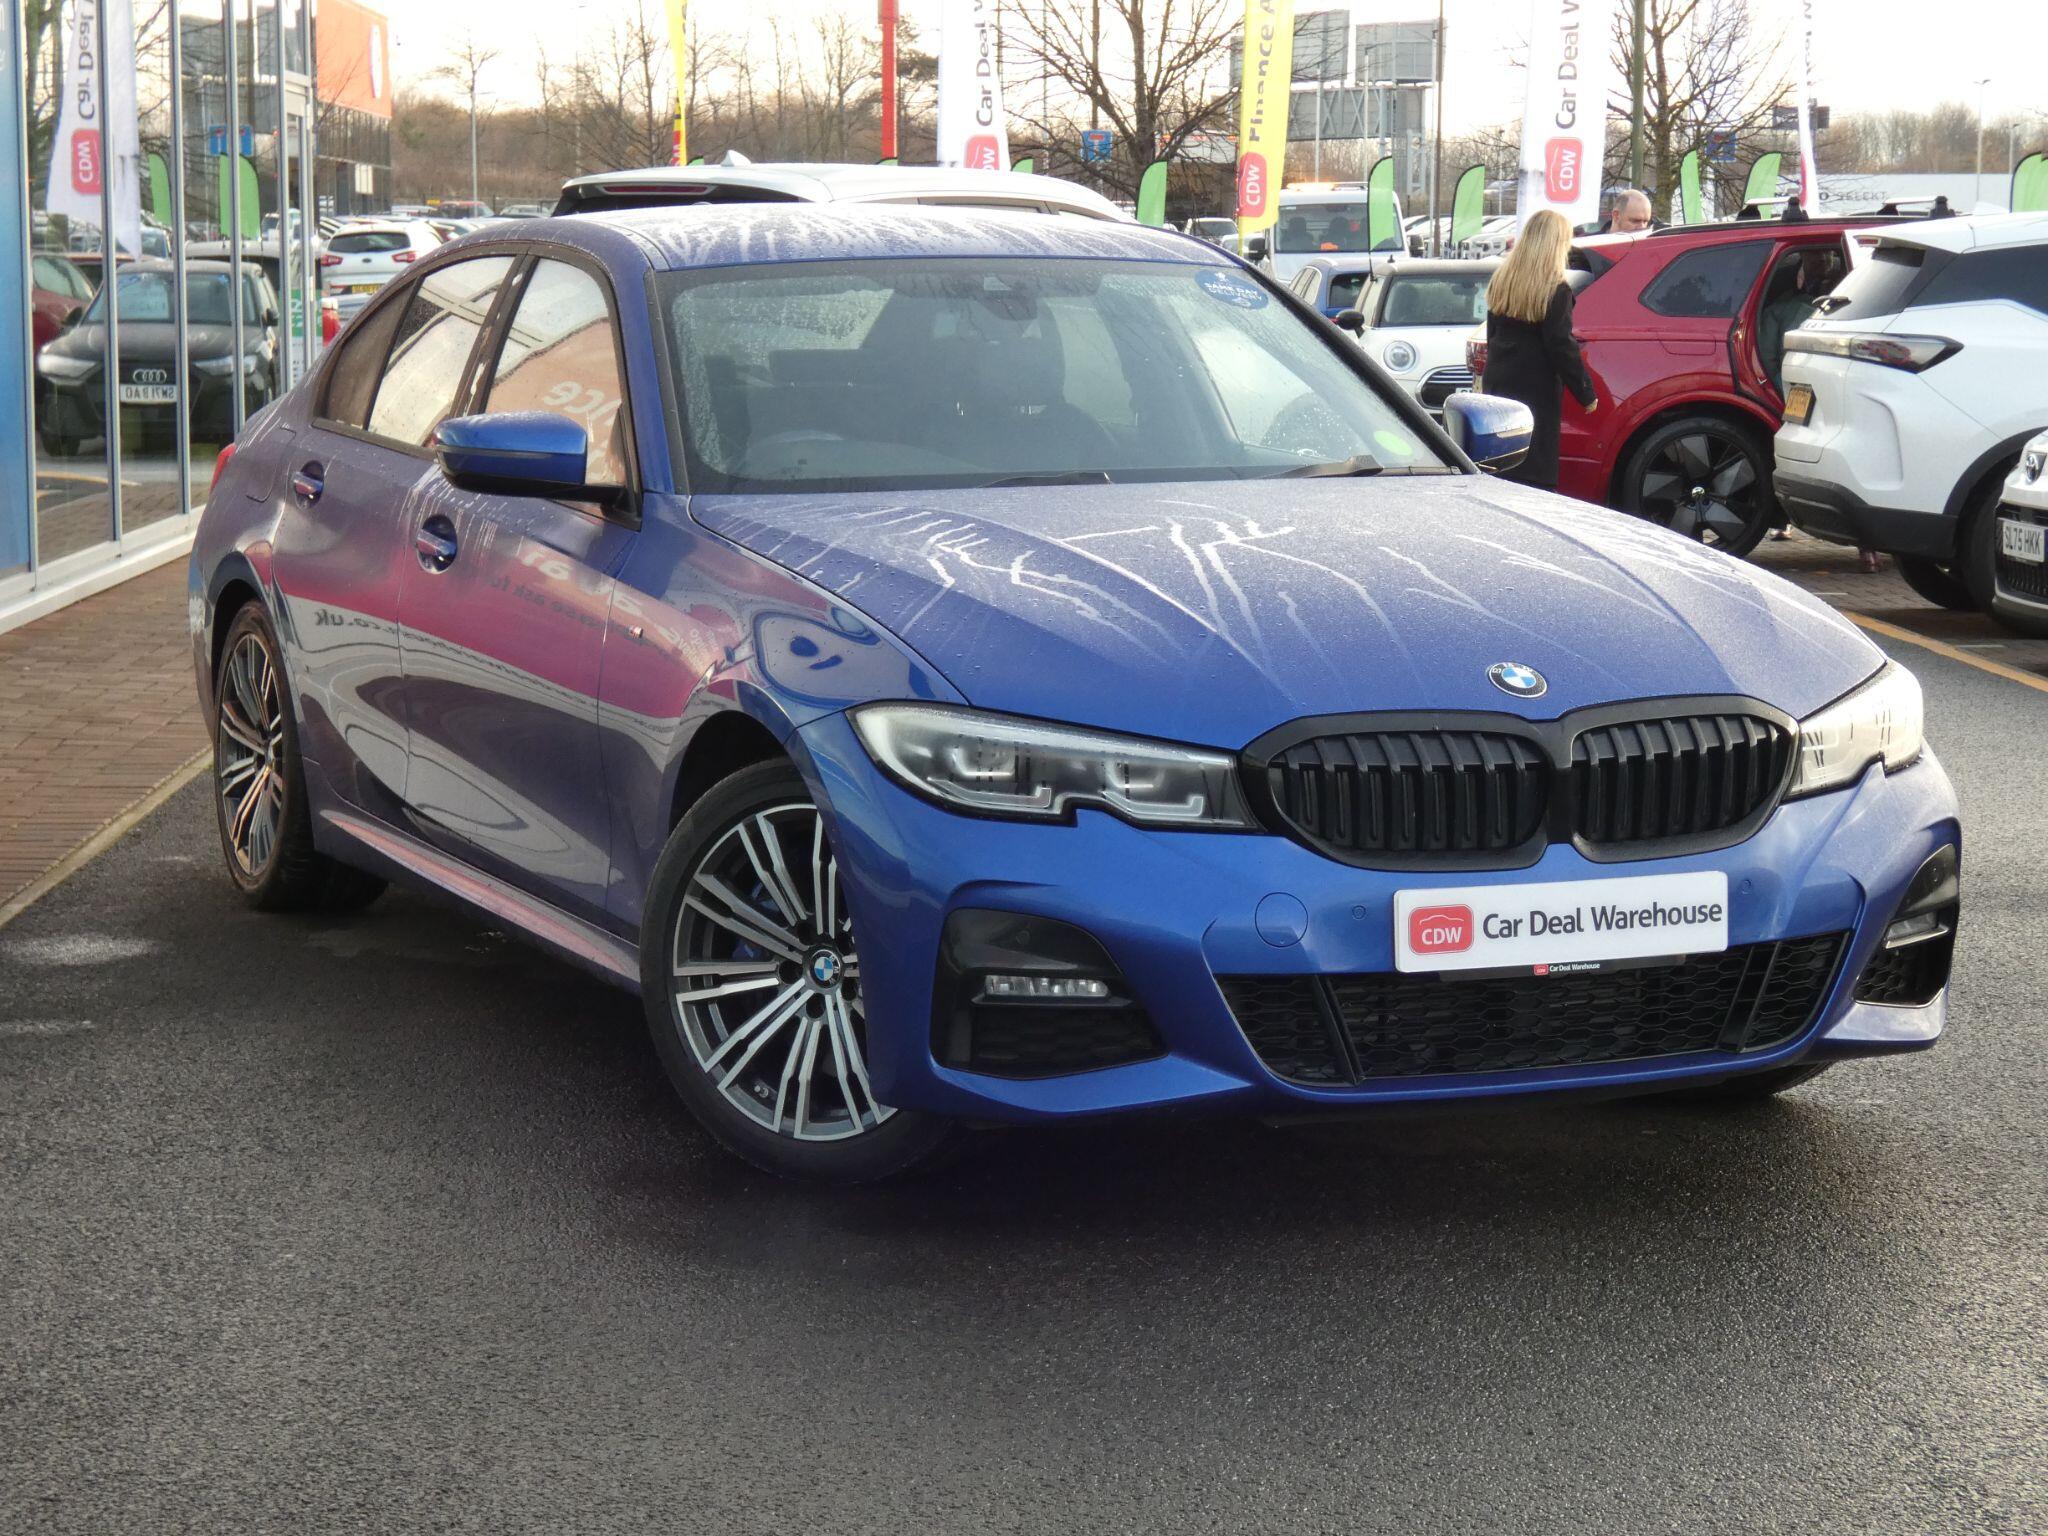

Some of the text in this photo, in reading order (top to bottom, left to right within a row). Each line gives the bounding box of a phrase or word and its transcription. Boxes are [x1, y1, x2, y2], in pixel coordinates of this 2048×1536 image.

[974, 20, 991, 78] Deal
[1557, 22, 1580, 81] Deal
[1249, 24, 1274, 142] Finance
[976, 85, 993, 127] Car
[1555, 87, 1577, 130] Car
[1245, 164, 1261, 206] CDW
[1559, 148, 1577, 191] CDW
[1421, 927, 1463, 945] CDW
[1482, 901, 1723, 939] Car Deal Warehouse
[1572, 963, 1600, 971] Warehouse
